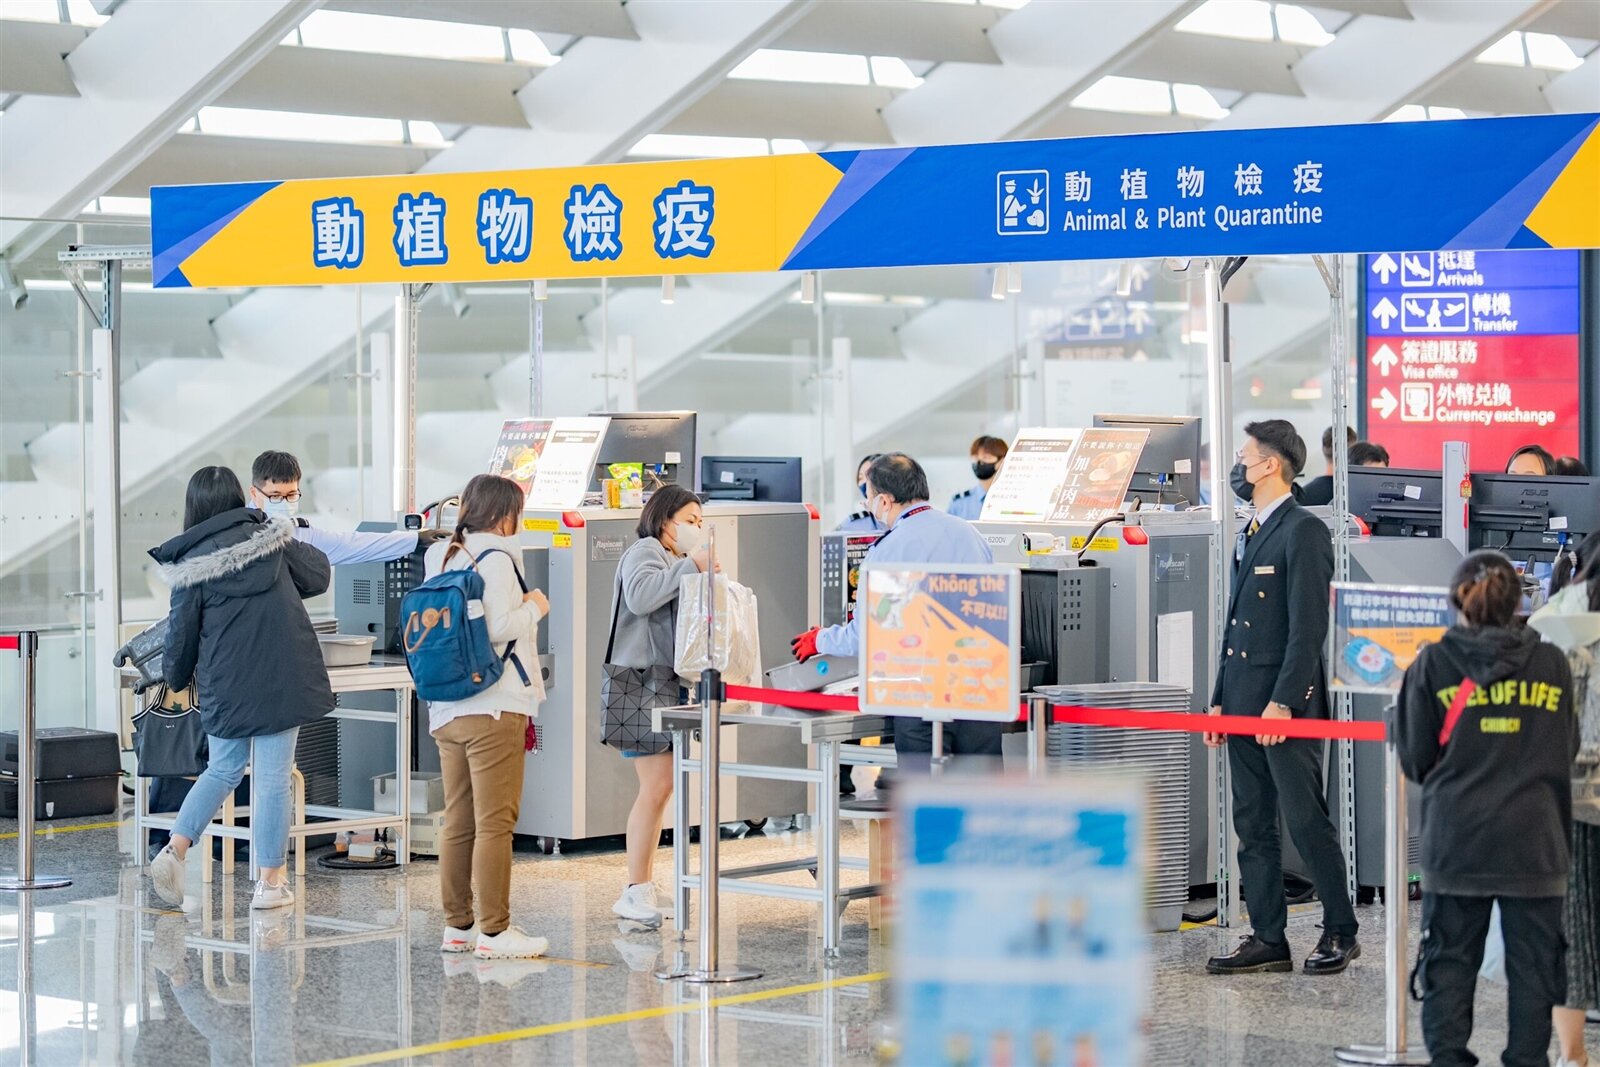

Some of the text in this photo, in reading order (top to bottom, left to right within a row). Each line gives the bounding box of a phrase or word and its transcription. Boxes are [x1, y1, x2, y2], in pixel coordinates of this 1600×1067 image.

[1064, 160, 1324, 204] 動植物檢疫
[312, 180, 716, 269] 動植物檢疫
[1063, 201, 1324, 233] Animal & Plant Quarantine
[1437, 271, 1484, 287] Arrivals
[1472, 293, 1512, 316] 轉機
[1472, 317, 1518, 332] Transfer
[1402, 364, 1459, 379] Visa office
[1436, 407, 1556, 426] Currency exchange
[1520, 488, 1550, 497] ASUS
[928, 574, 978, 597] Không
[1436, 680, 1563, 712] TEE OF LIFE
